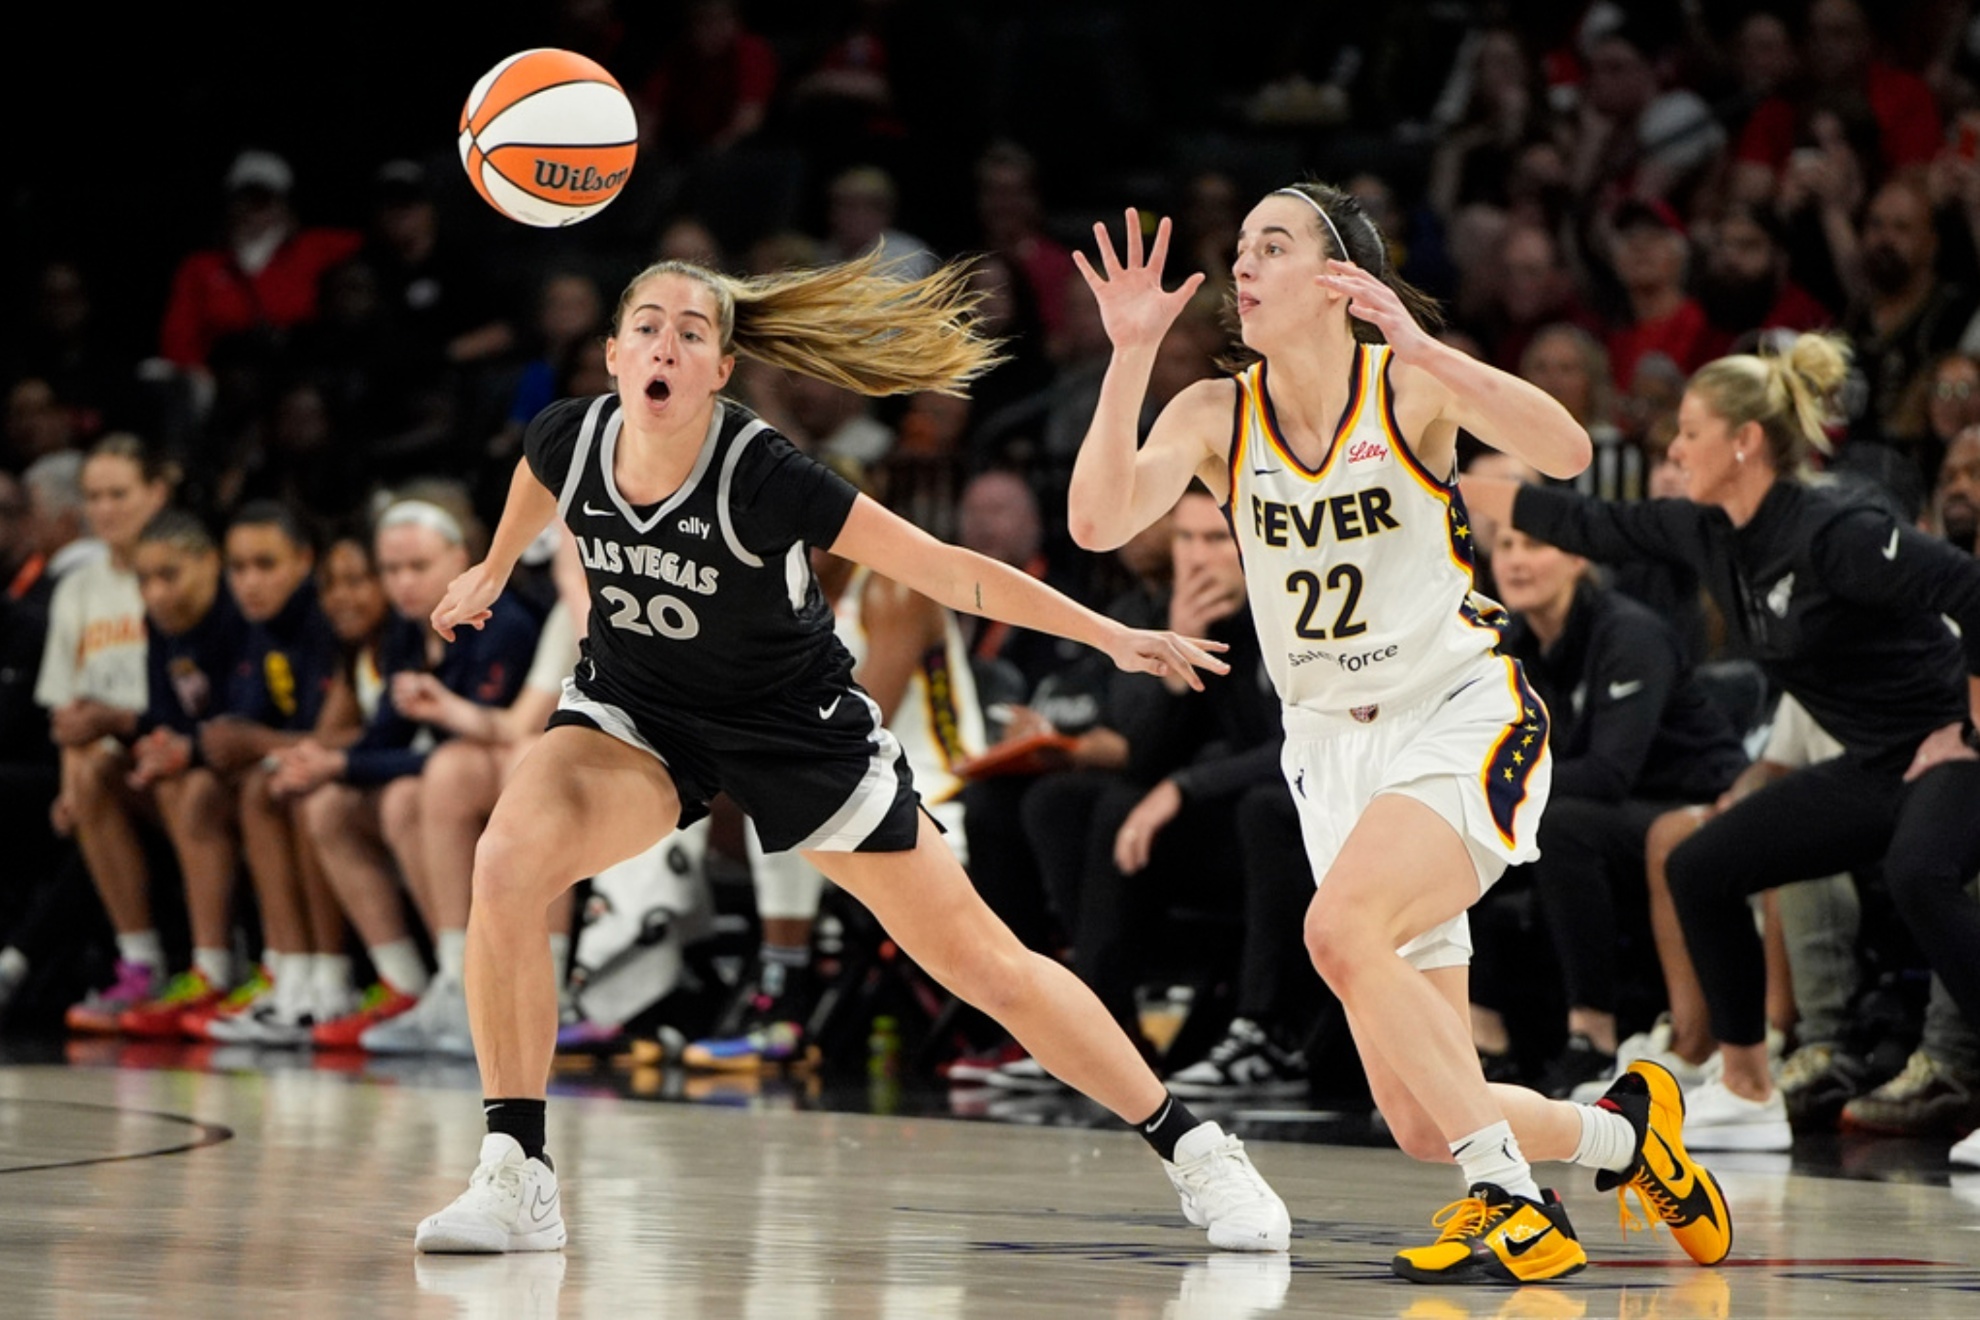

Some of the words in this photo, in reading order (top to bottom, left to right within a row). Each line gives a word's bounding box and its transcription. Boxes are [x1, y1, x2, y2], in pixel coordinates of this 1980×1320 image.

[535, 159, 629, 191] Wilson
[1348, 440, 1388, 463] Lilly
[677, 517, 711, 540] ally
[1251, 487, 1402, 548] FEVER
[576, 536, 623, 574] LAS
[623, 545, 720, 596] VEGAS
[600, 585, 699, 640] 20
[1286, 563, 1368, 640] 22
